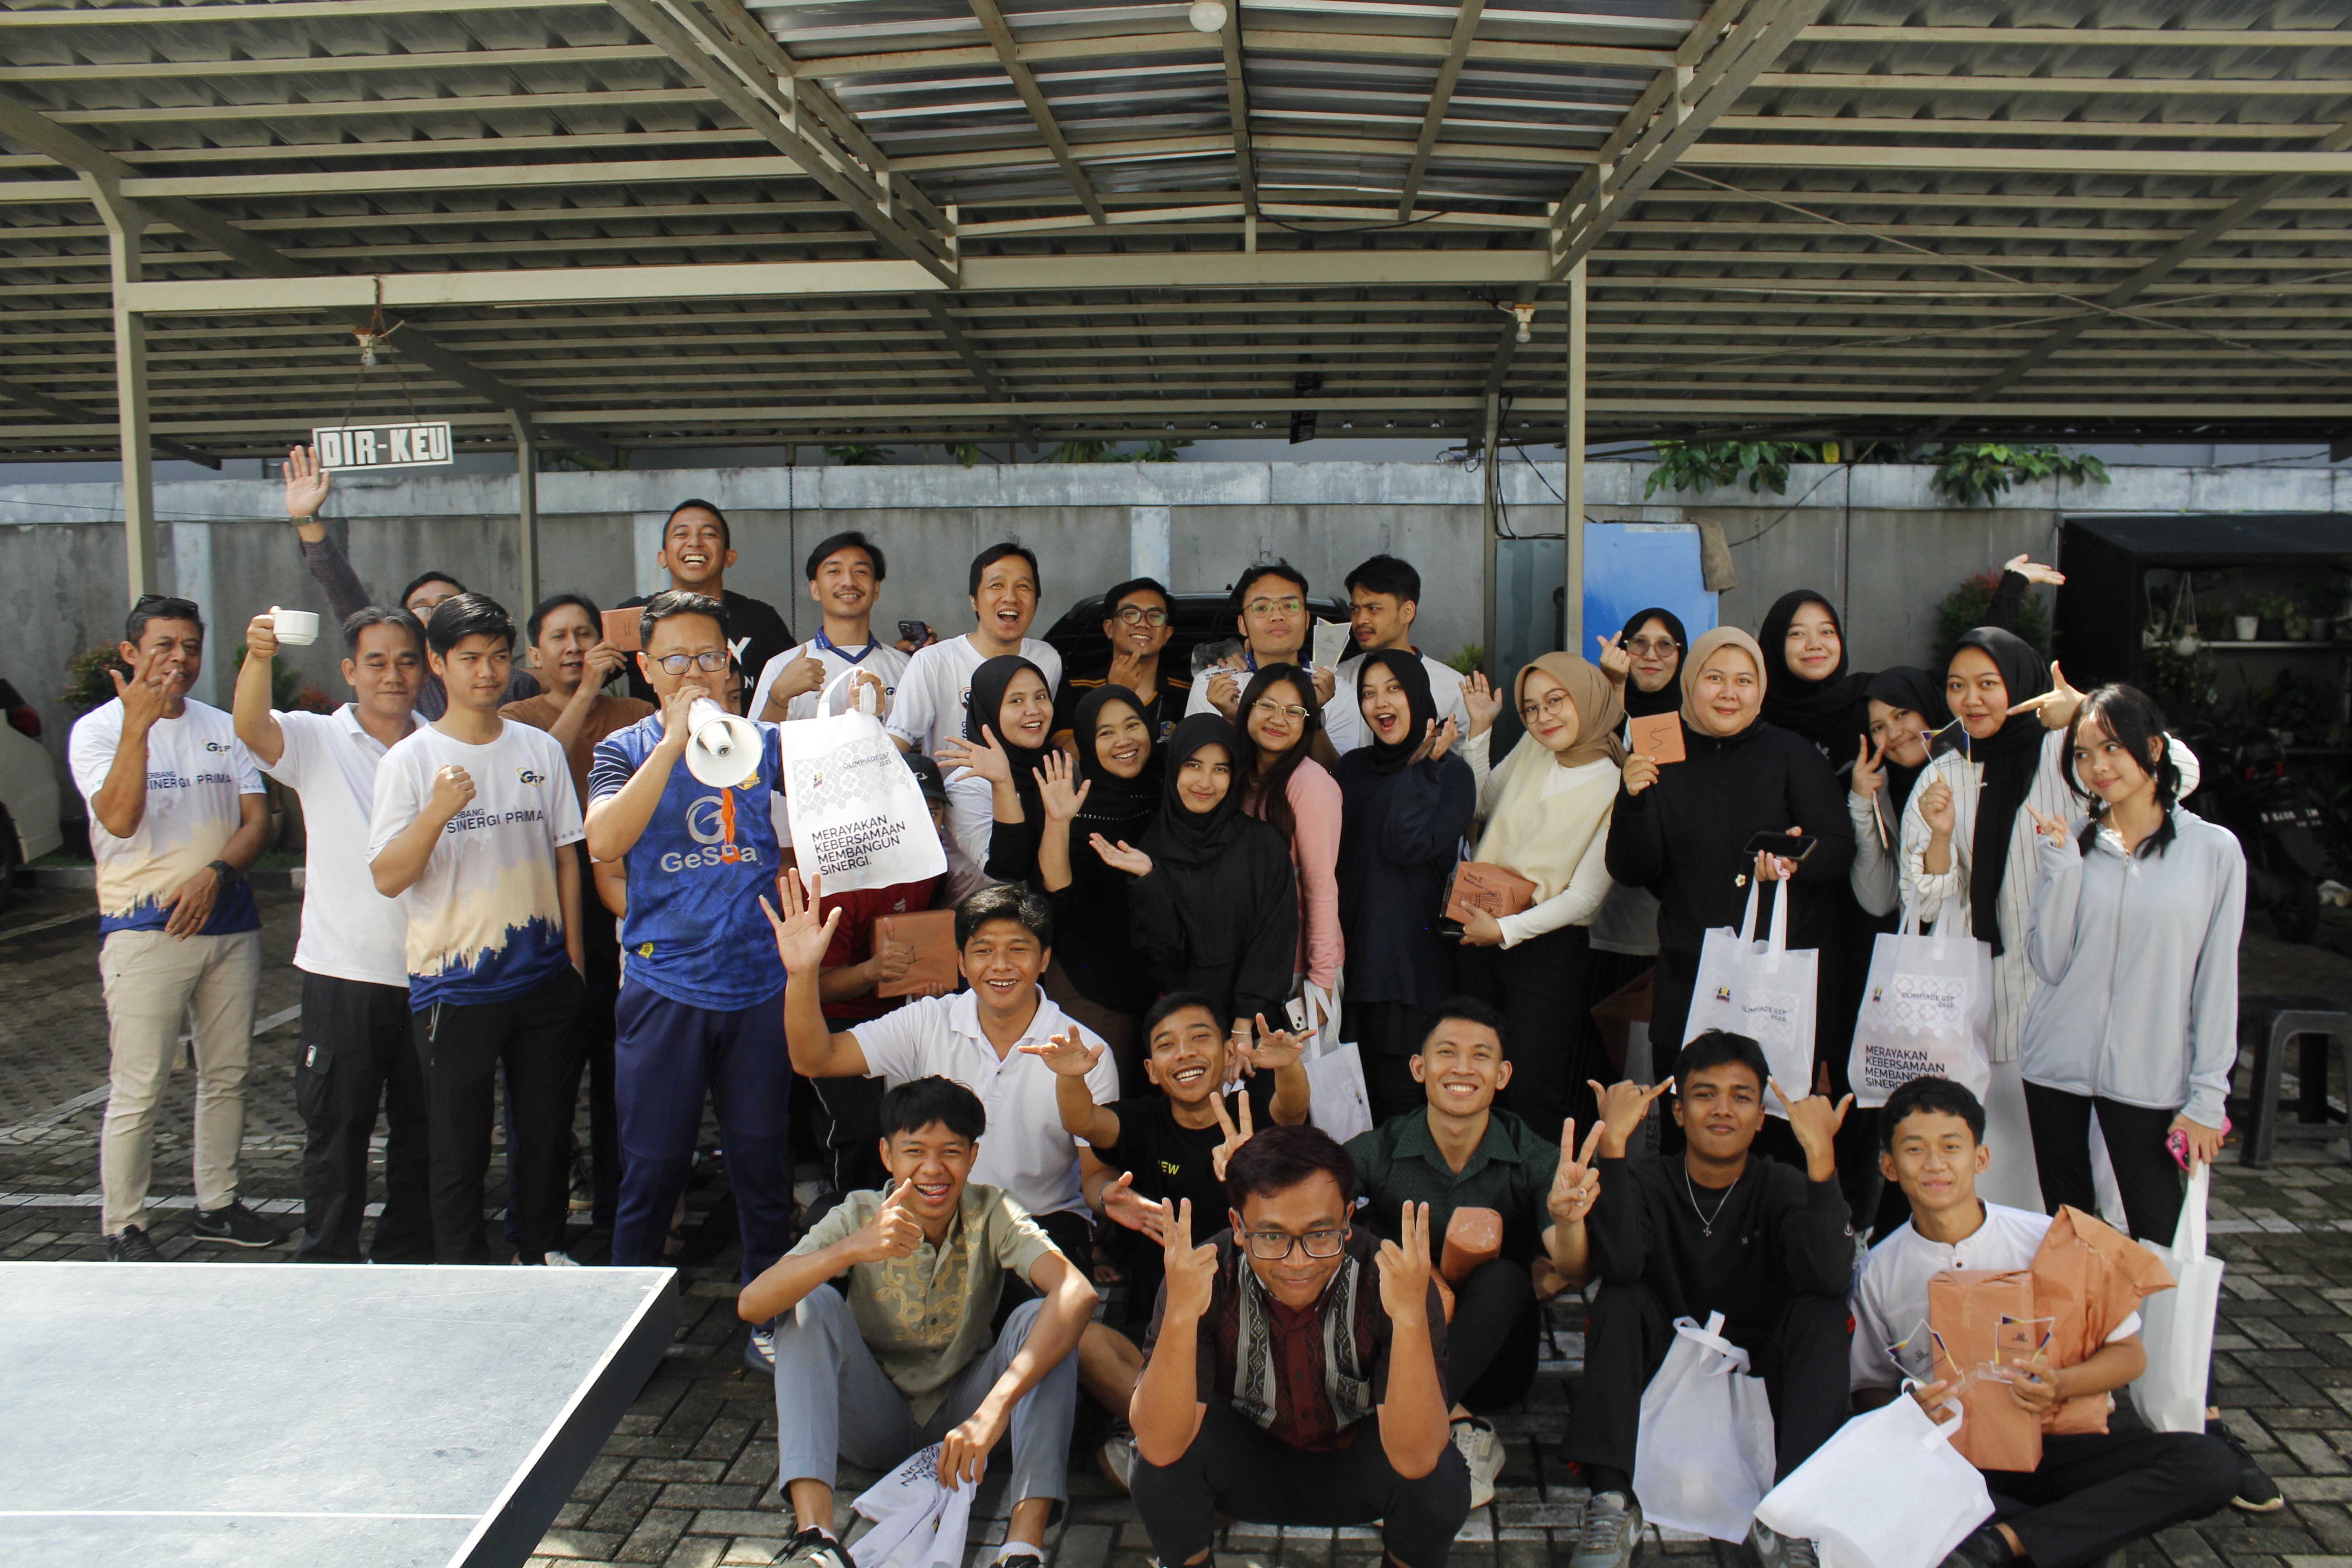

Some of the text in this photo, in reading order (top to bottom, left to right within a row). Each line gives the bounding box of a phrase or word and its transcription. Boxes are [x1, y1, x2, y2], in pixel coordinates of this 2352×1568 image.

[320, 427, 446, 466] DIR-KEU
[843, 754, 879, 769] OLIMPIADE
[146, 771, 176, 779] ERBANG
[146, 774, 232, 790] INERGI PRIMA
[451, 808, 485, 820] RBANG
[446, 813, 500, 833] SINERGI
[812, 814, 888, 843] MERAYAKAN
[814, 821, 906, 854] KEBERSAMAAN
[818, 835, 901, 865] MEMBANGUN
[820, 855, 872, 875] SINERGI.
[1866, 1044, 1928, 1061] MERAYAKAN
[1866, 1055, 1945, 1073] KEBERSAMAAN
[1865, 1066, 1935, 1081] MEMBAN
[1865, 1077, 1903, 1089] SINER
[1158, 1159, 1180, 1176] EW
